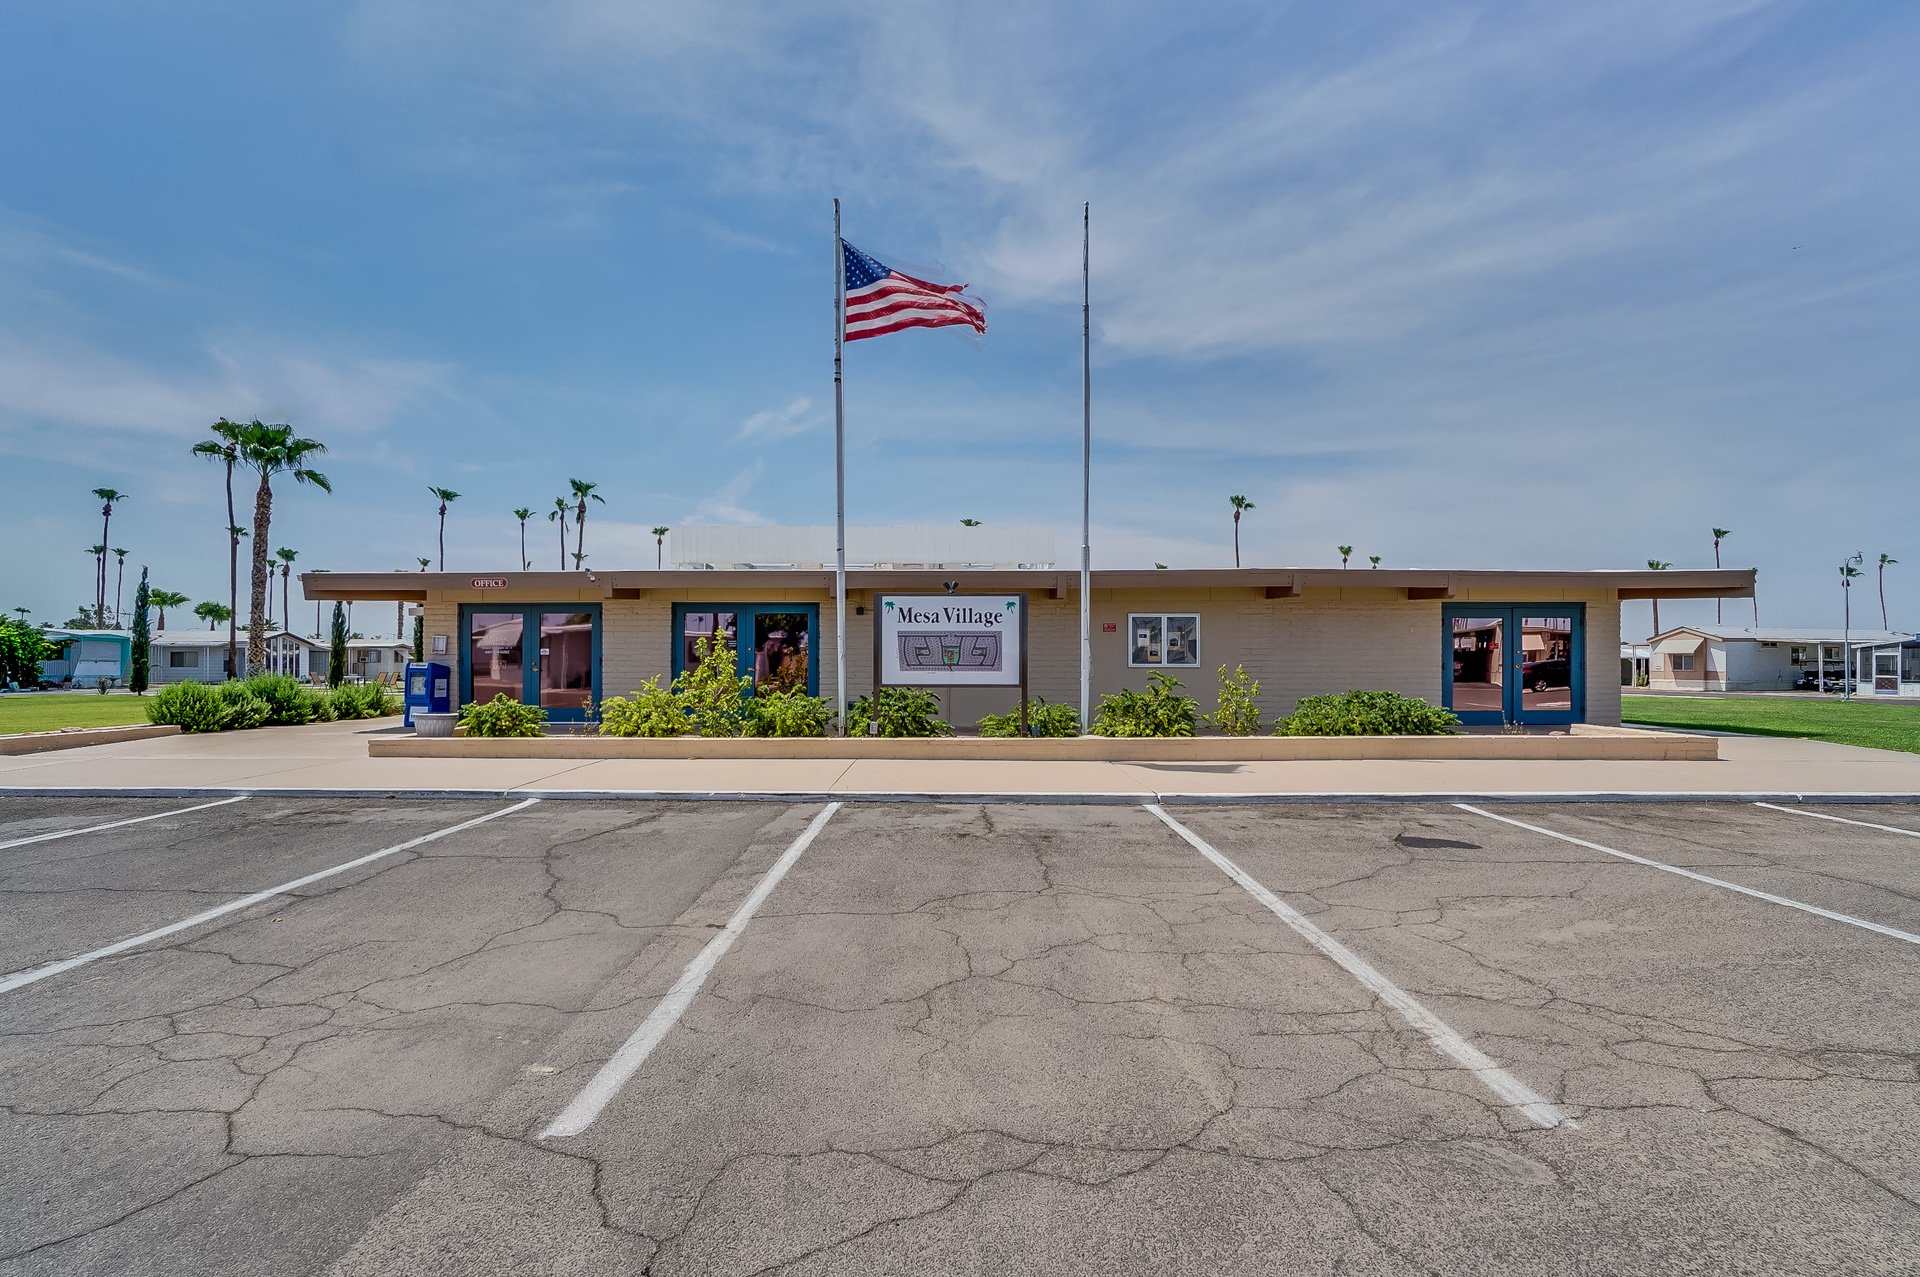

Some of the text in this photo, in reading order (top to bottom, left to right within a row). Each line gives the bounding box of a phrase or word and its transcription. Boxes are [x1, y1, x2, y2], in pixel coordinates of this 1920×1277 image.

[474, 579, 504, 587] OFFICE
[897, 606, 1003, 628] Mesa Village
